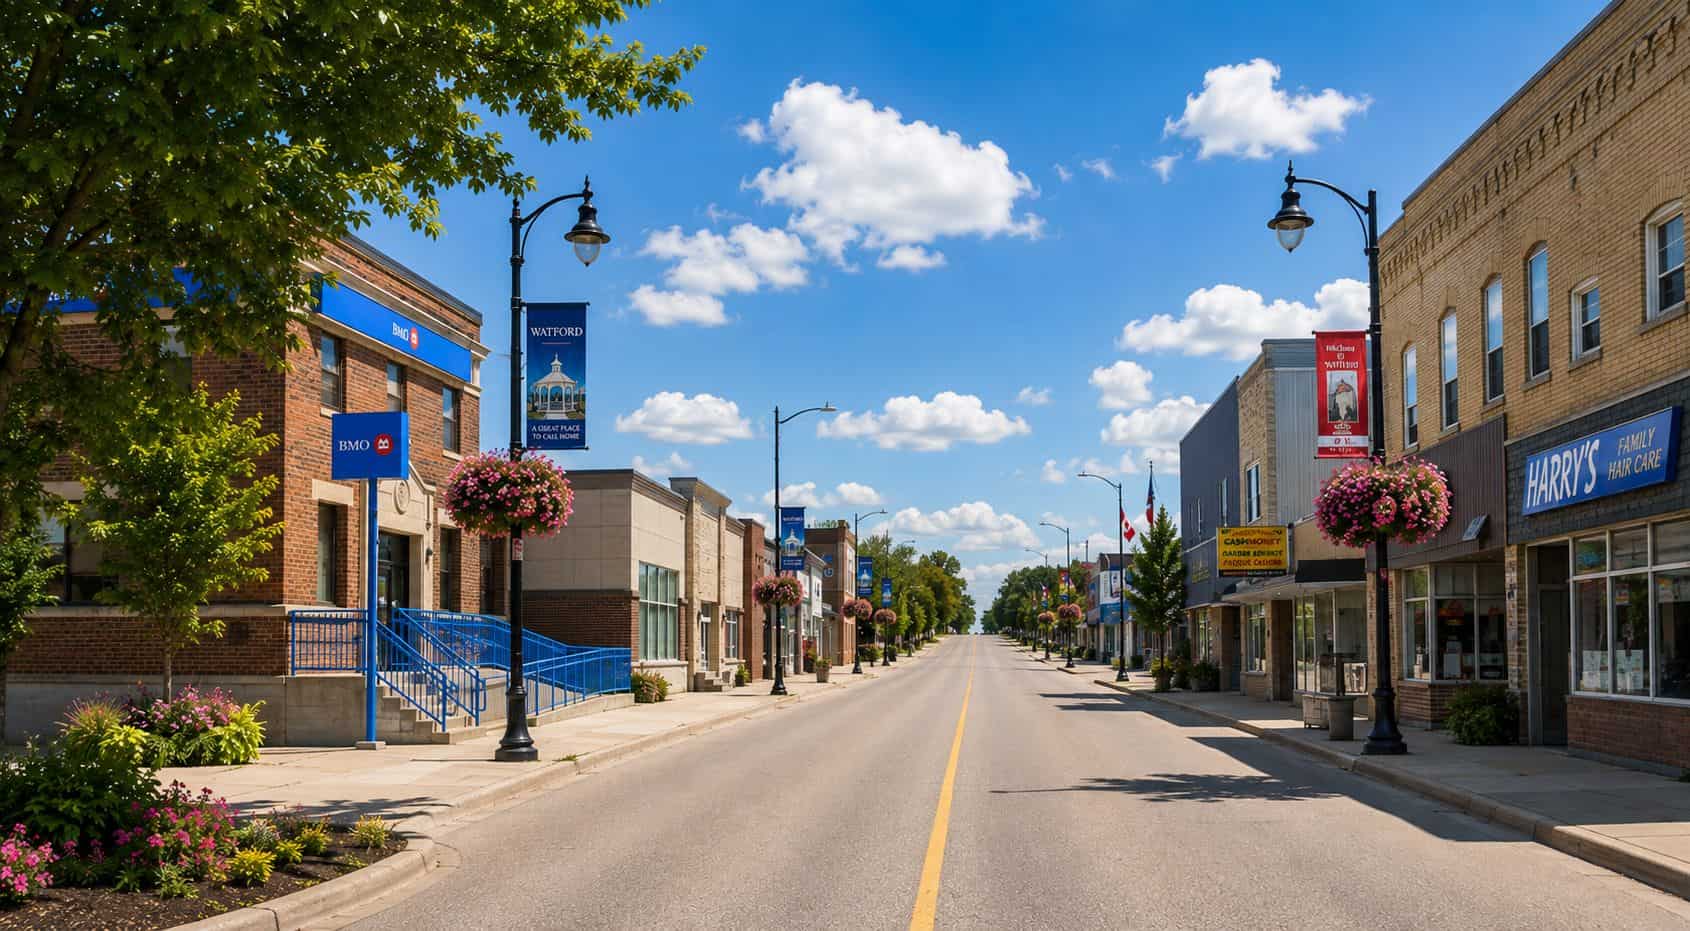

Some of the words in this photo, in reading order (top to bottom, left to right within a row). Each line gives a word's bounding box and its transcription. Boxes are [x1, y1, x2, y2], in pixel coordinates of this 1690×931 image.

[392, 322, 409, 342] BMO
[530, 327, 584, 337] WATFORD
[339, 439, 370, 451] BMO
[1617, 426, 1656, 456] FAMILY
[1526, 438, 1600, 509] HARRY'S
[1607, 457, 1632, 481] HAIR
[1634, 448, 1663, 475] CARE
